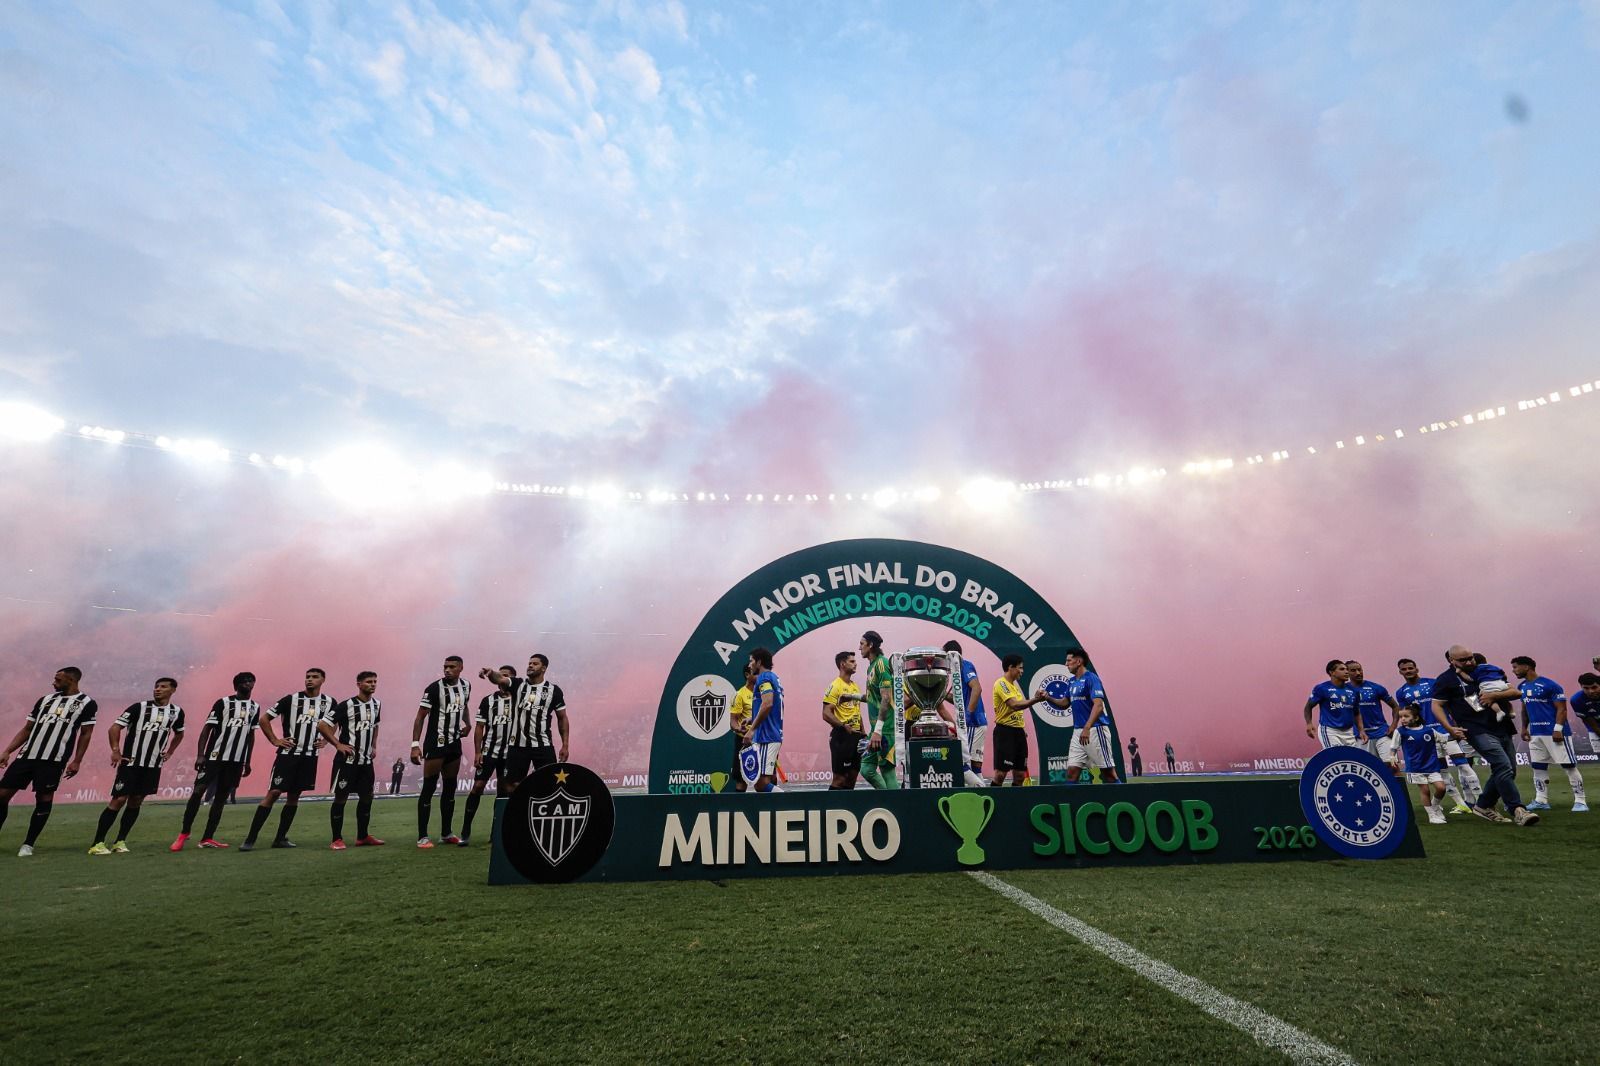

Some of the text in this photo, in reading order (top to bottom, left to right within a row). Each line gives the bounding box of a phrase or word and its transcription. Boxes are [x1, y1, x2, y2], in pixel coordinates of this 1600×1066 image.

[713, 562, 1045, 665] A MAIOR FINAL DO BRASIL
[772, 591, 992, 645] MINEIRO SICOOB 2026
[928, 765, 935, 774] A
[1254, 758, 1304, 770] MINEIRO
[668, 773, 711, 784] MINEIRO
[806, 771, 833, 781] SICOO
[920, 773, 953, 783] MAIOR
[1320, 764, 1381, 788] CRUZEIRO
[538, 803, 580, 816] CAM
[1318, 795, 1392, 842] ESPORTE CLUBE
[658, 799, 1317, 867] MINEIRO SICOOB 2026
